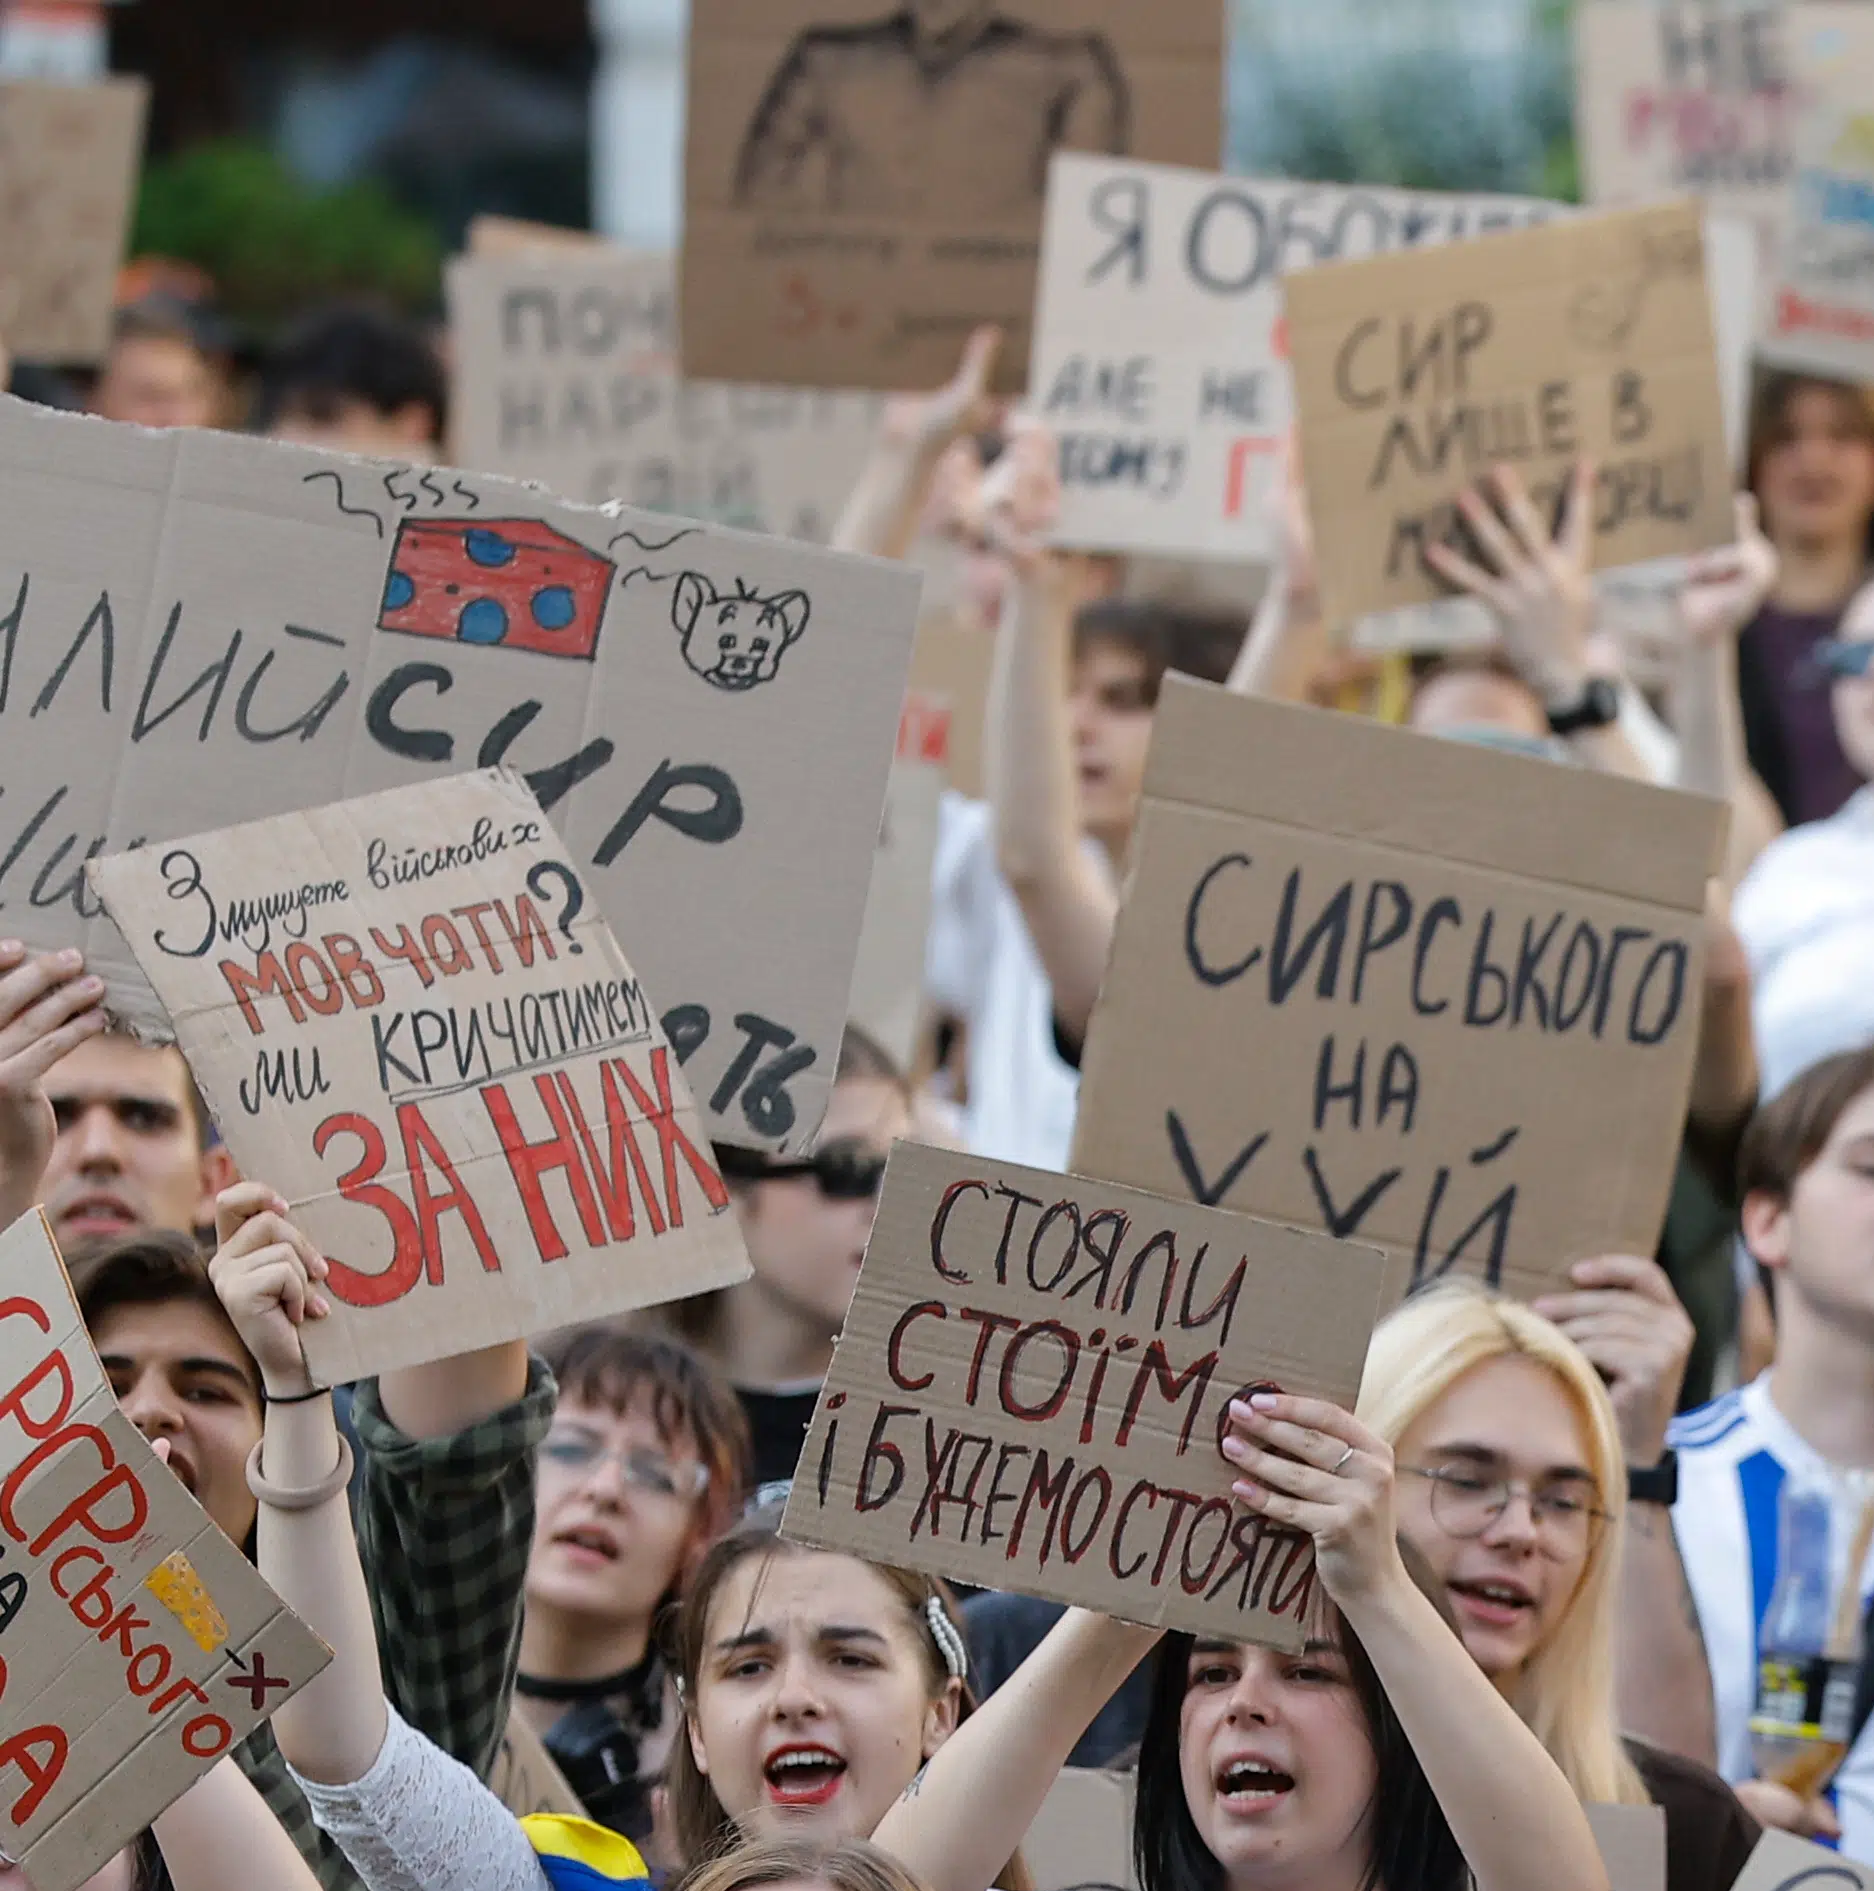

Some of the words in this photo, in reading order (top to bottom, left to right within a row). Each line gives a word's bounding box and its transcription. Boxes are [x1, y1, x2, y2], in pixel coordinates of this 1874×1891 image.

[1086, 176, 1150, 288] Я
[1333, 298, 1493, 411] СИР
[1611, 366, 1656, 445] В
[366, 815, 543, 893] військових
[1184, 853, 1690, 1047] СИРСЬКОГО
[237, 1043, 331, 1118] ми
[1313, 1034, 1422, 1134] НА
[311, 1093, 501, 1310] ЗА
[477, 1043, 733, 1265] НИХ
[930, 1178, 1249, 1348] СТОЯЛИ
[854, 1403, 1113, 1575] БУДЕМО
